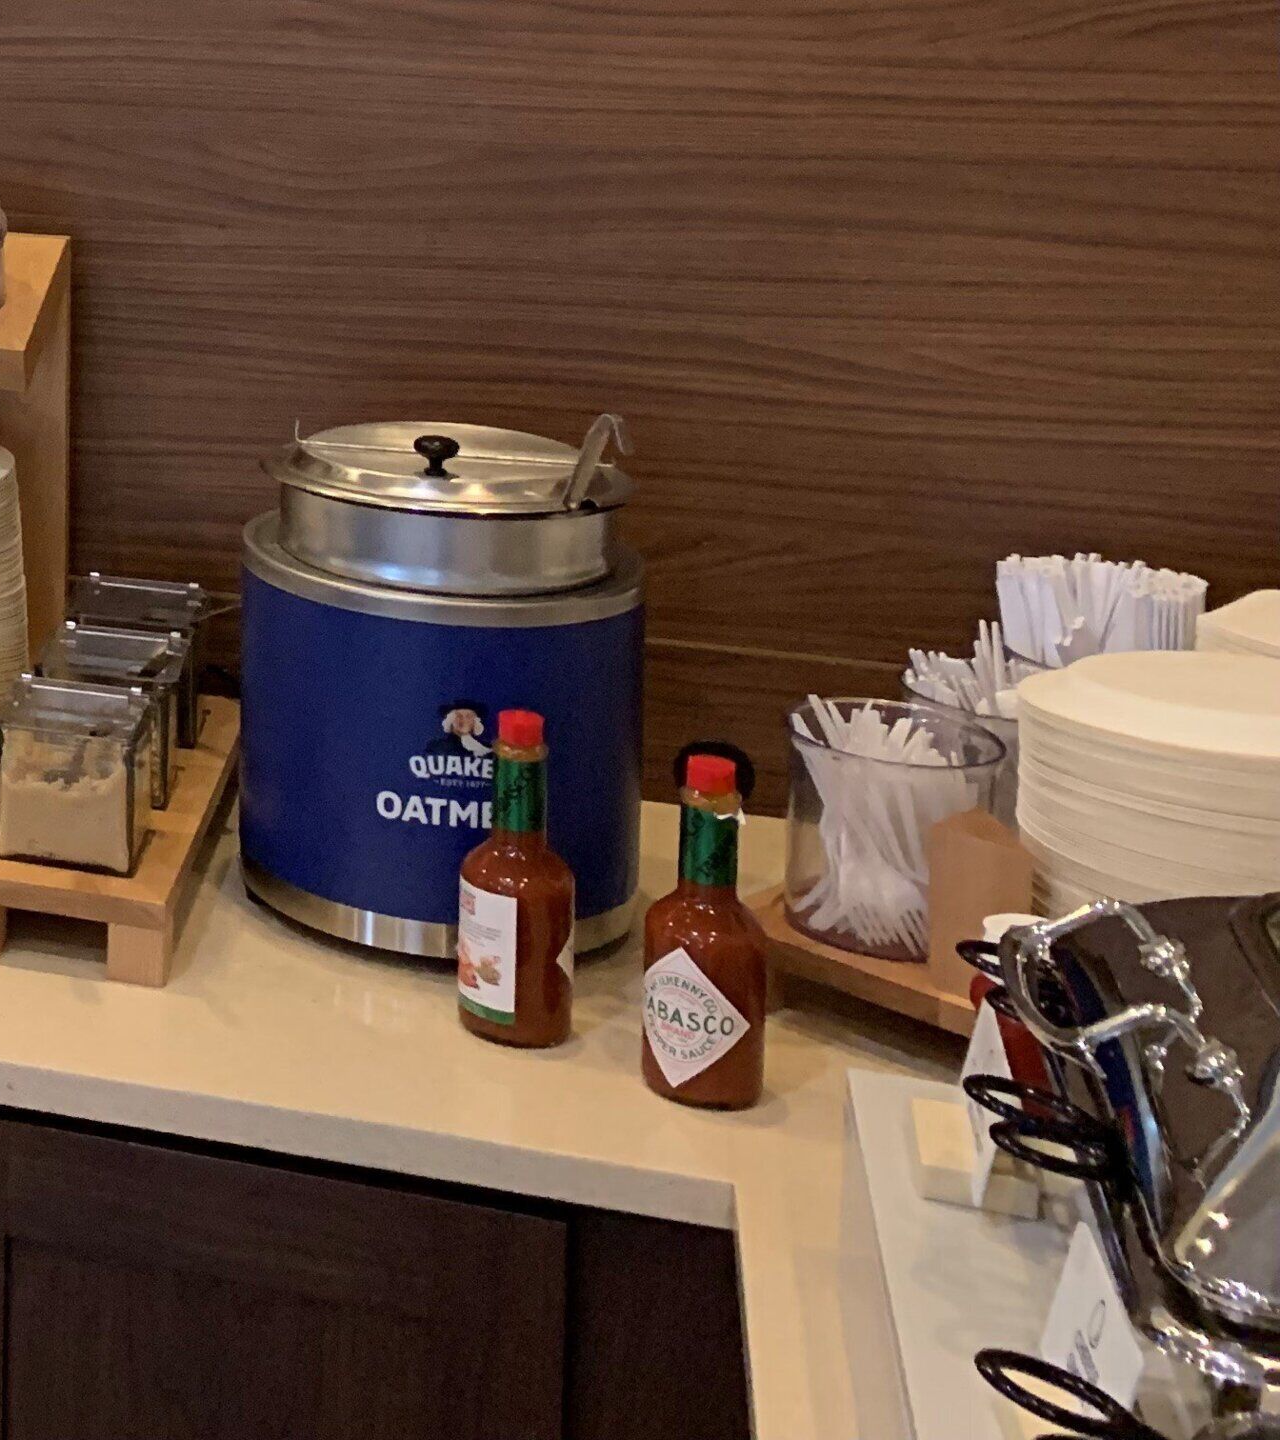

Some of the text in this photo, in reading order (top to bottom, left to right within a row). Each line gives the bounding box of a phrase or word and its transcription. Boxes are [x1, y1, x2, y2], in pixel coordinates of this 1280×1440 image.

[409, 755, 494, 779] QUAKE
[376, 791, 493, 829] OATME
[646, 995, 735, 1036] ABASCO
